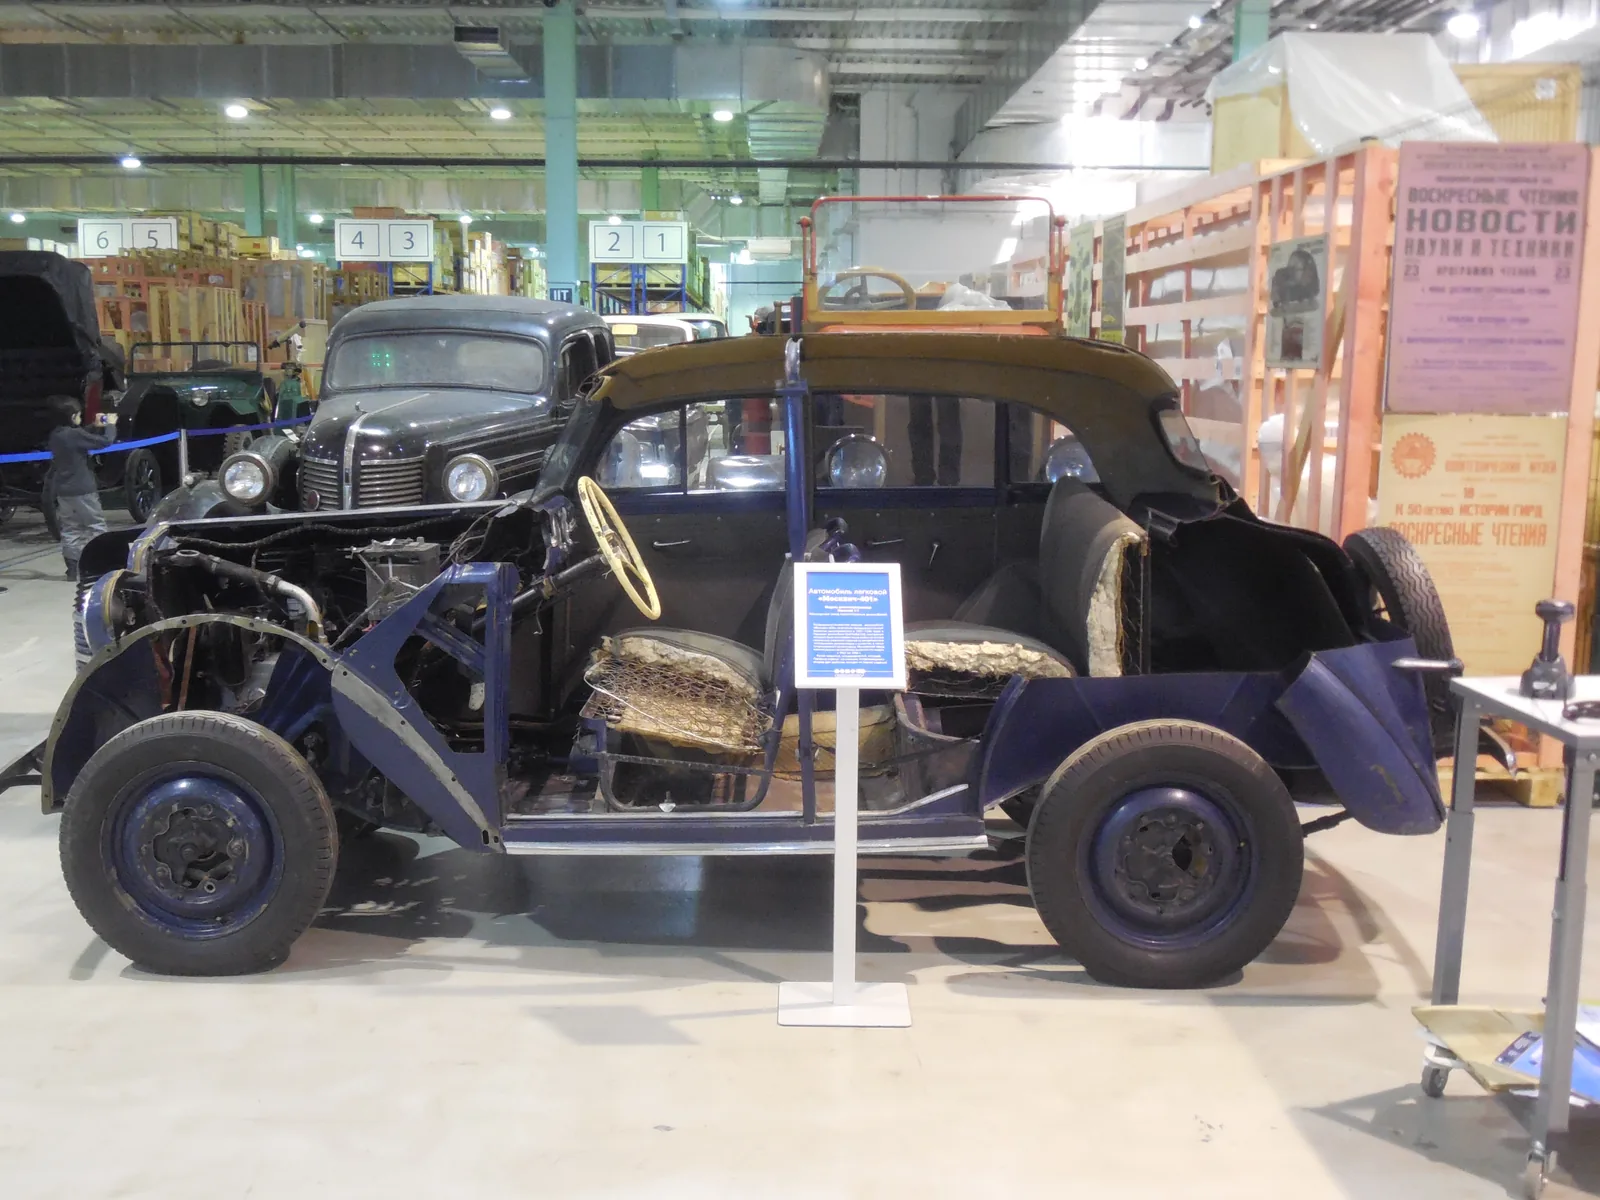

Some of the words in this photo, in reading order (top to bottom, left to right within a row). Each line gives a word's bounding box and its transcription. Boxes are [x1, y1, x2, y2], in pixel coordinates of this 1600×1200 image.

[1408, 187, 1510, 204] ВОСКРЕСНЫЕ
[1519, 188, 1578, 205] ЧТЕНИЯ
[1406, 208, 1577, 235] НОВОСТИ
[96, 230, 109, 249] 6
[147, 229, 159, 249] 5
[351, 230, 364, 250] 4
[403, 231, 414, 250] 3
[608, 231, 621, 251] 2
[657, 232, 665, 252] 1
[1404, 238, 1463, 257] НАУКИ
[1471, 238, 1481, 257] И
[1404, 264, 1420, 277] 23
[1555, 266, 1571, 279] 23
[1492, 523, 1547, 547] ЧТЕНИЯ
[854, 588, 887, 596] легковой
